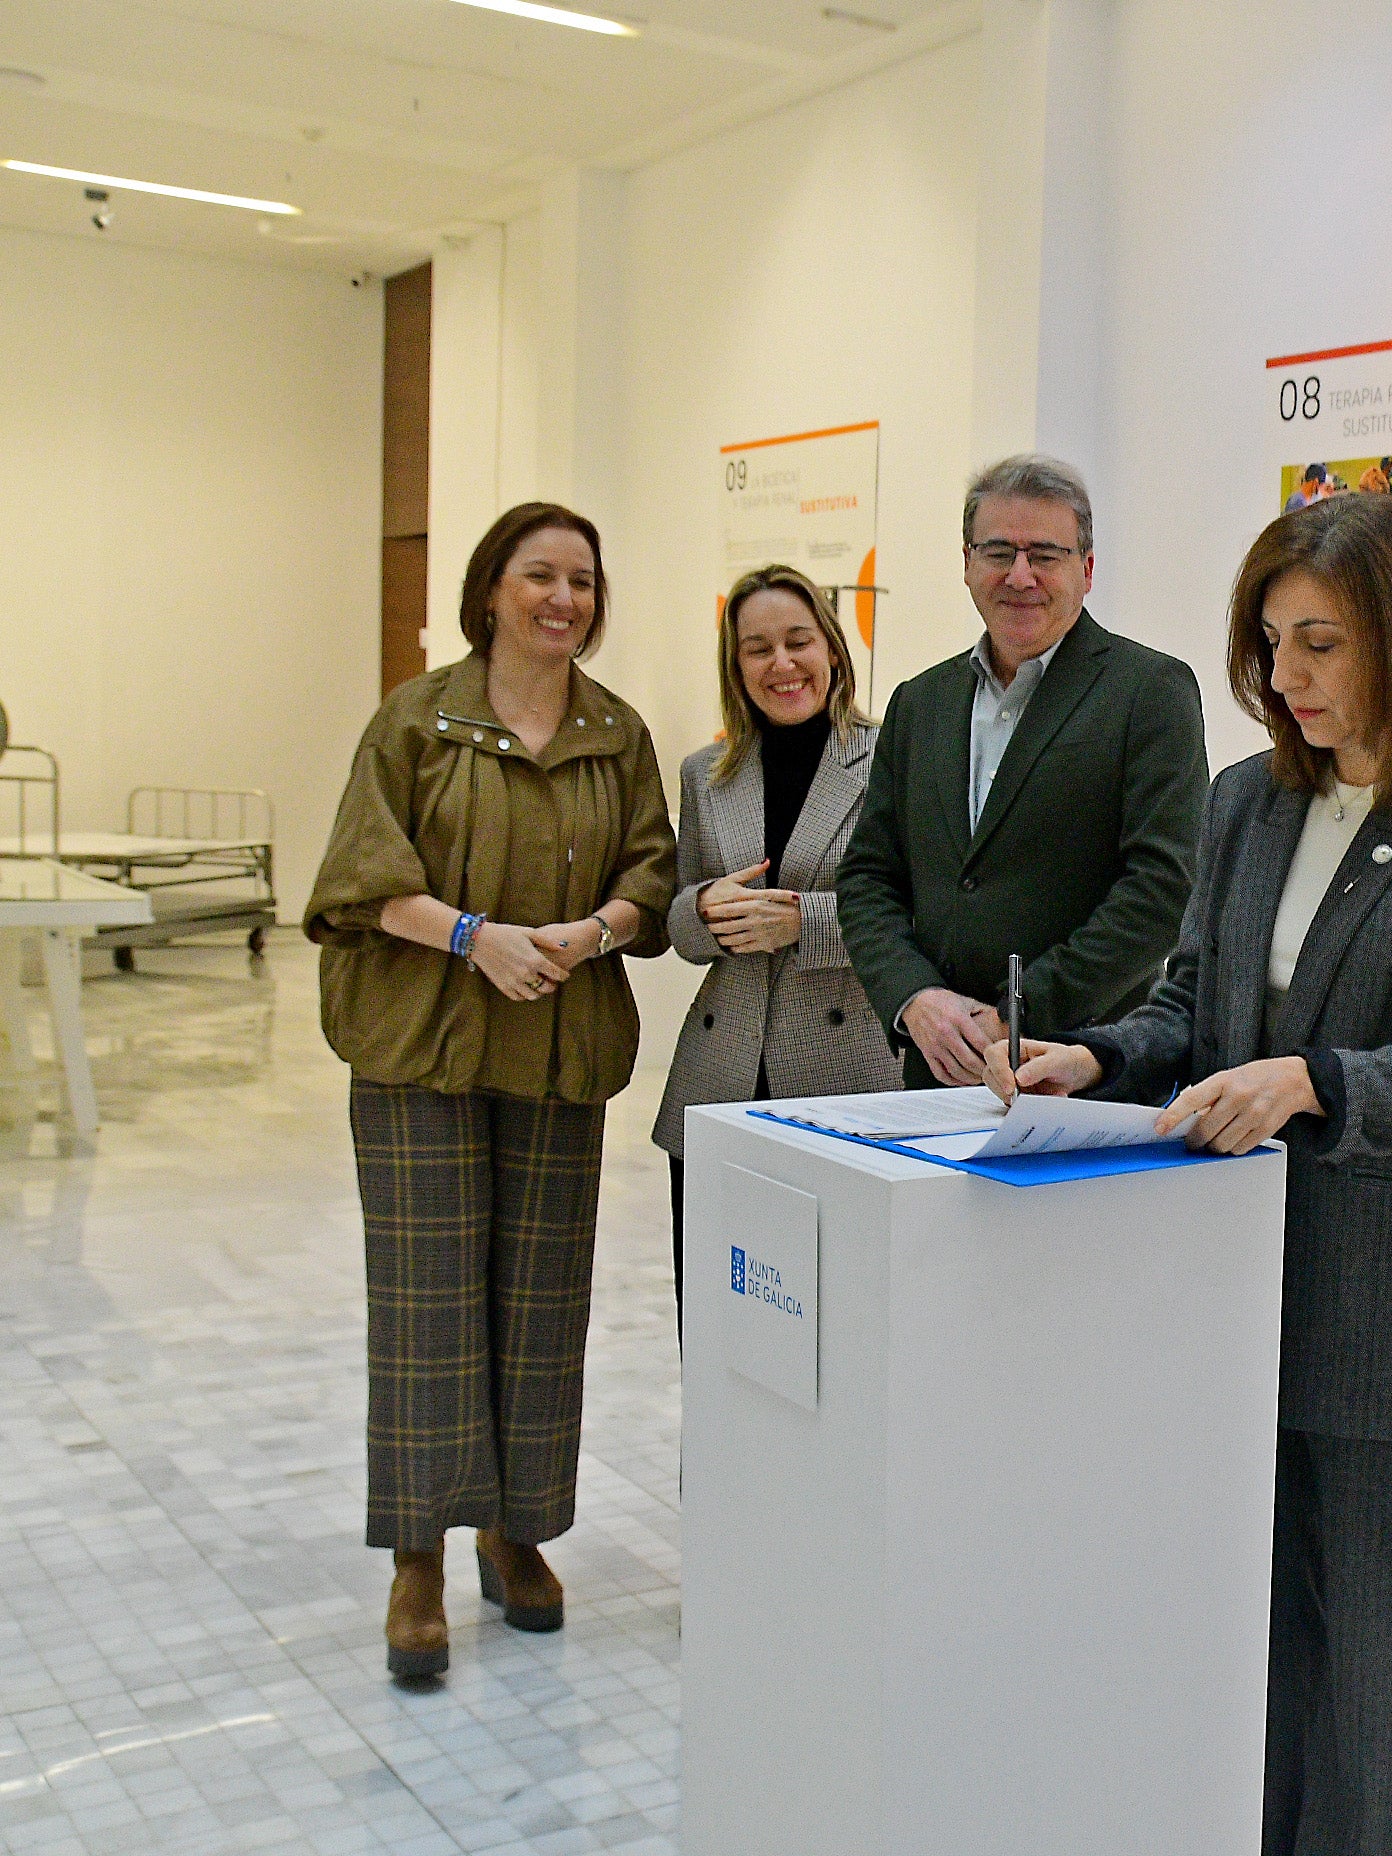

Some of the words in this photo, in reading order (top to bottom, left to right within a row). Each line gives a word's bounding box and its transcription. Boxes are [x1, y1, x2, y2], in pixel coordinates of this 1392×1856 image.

[1280, 376, 1320, 420] 08
[1328, 387, 1383, 410] TERAPIA
[725, 460, 747, 491] 09
[748, 1257, 782, 1288] XUNTA
[748, 1278, 761, 1299] DE
[763, 1286, 803, 1319] GALICIA
